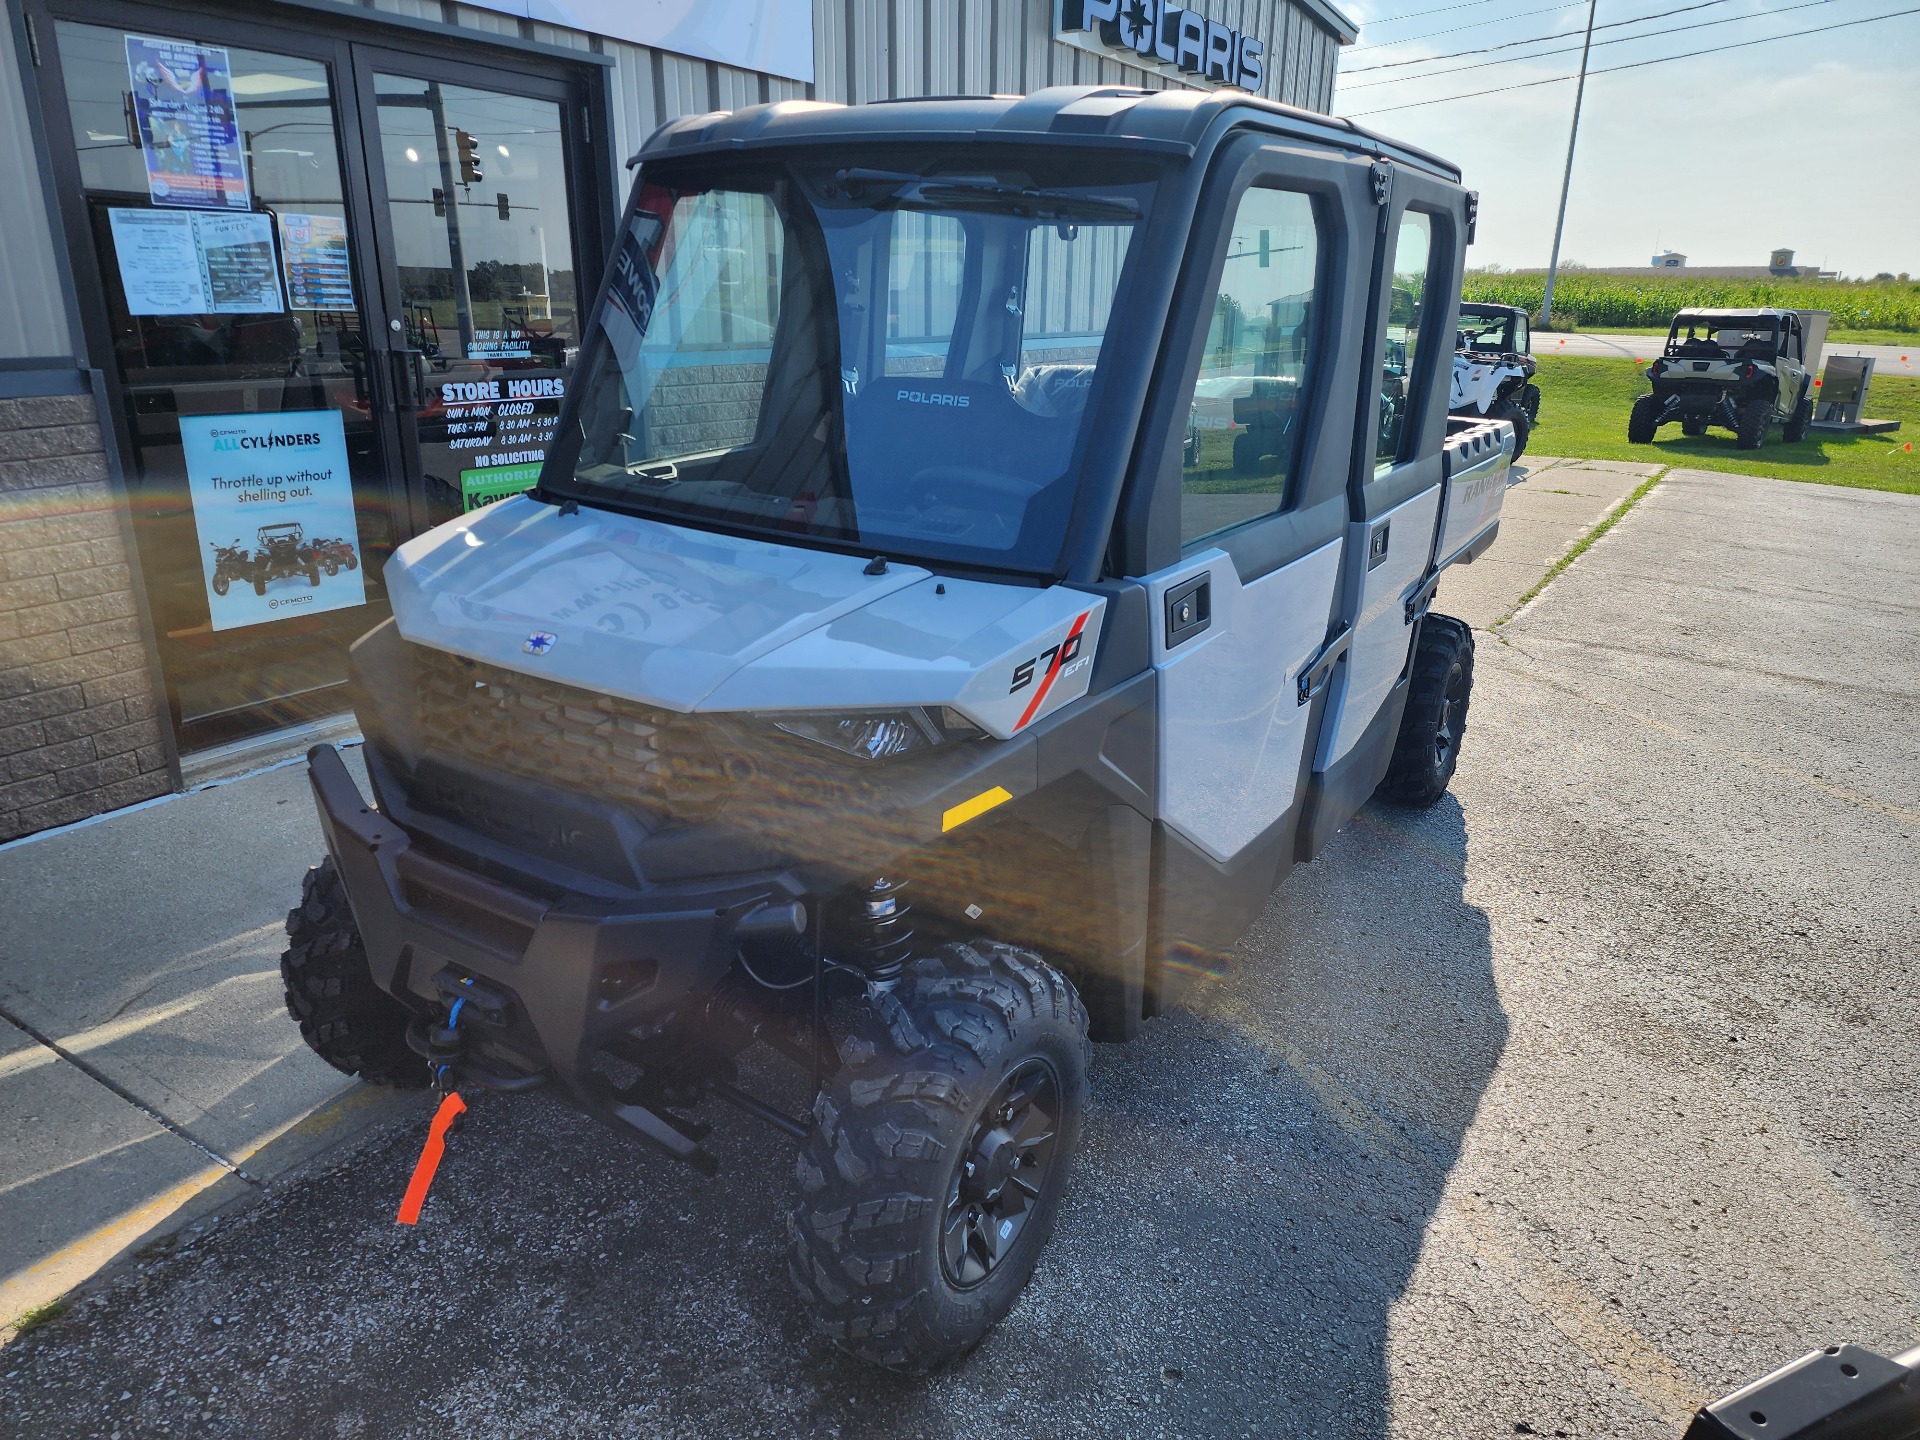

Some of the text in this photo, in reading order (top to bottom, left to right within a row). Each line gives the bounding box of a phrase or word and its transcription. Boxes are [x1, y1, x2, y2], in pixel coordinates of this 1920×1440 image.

[1080, 0, 1263, 92] POLARIS
[475, 330, 521, 340] THIS IS A NO
[467, 340, 530, 351] SMOKING FACILITY
[442, 378, 565, 401] STORE HOURS
[897, 390, 970, 407] POLARIS
[446, 407, 464, 419] SUN
[471, 406, 491, 417] MON
[498, 402, 534, 417] CLOSED
[447, 423, 467, 434] TUES
[474, 421, 488, 432] FRI
[517, 418, 531, 429] AM
[449, 436, 492, 450] SATURDAY
[518, 434, 532, 444] AM
[475, 449, 545, 468] NO SOLICITING
[211, 469, 332, 489] Throttle up without
[238, 485, 313, 503] shelling out.
[280, 595, 313, 606] CFMOTO
[1009, 631, 1083, 695] 570
[1064, 655, 1090, 677] EFI
